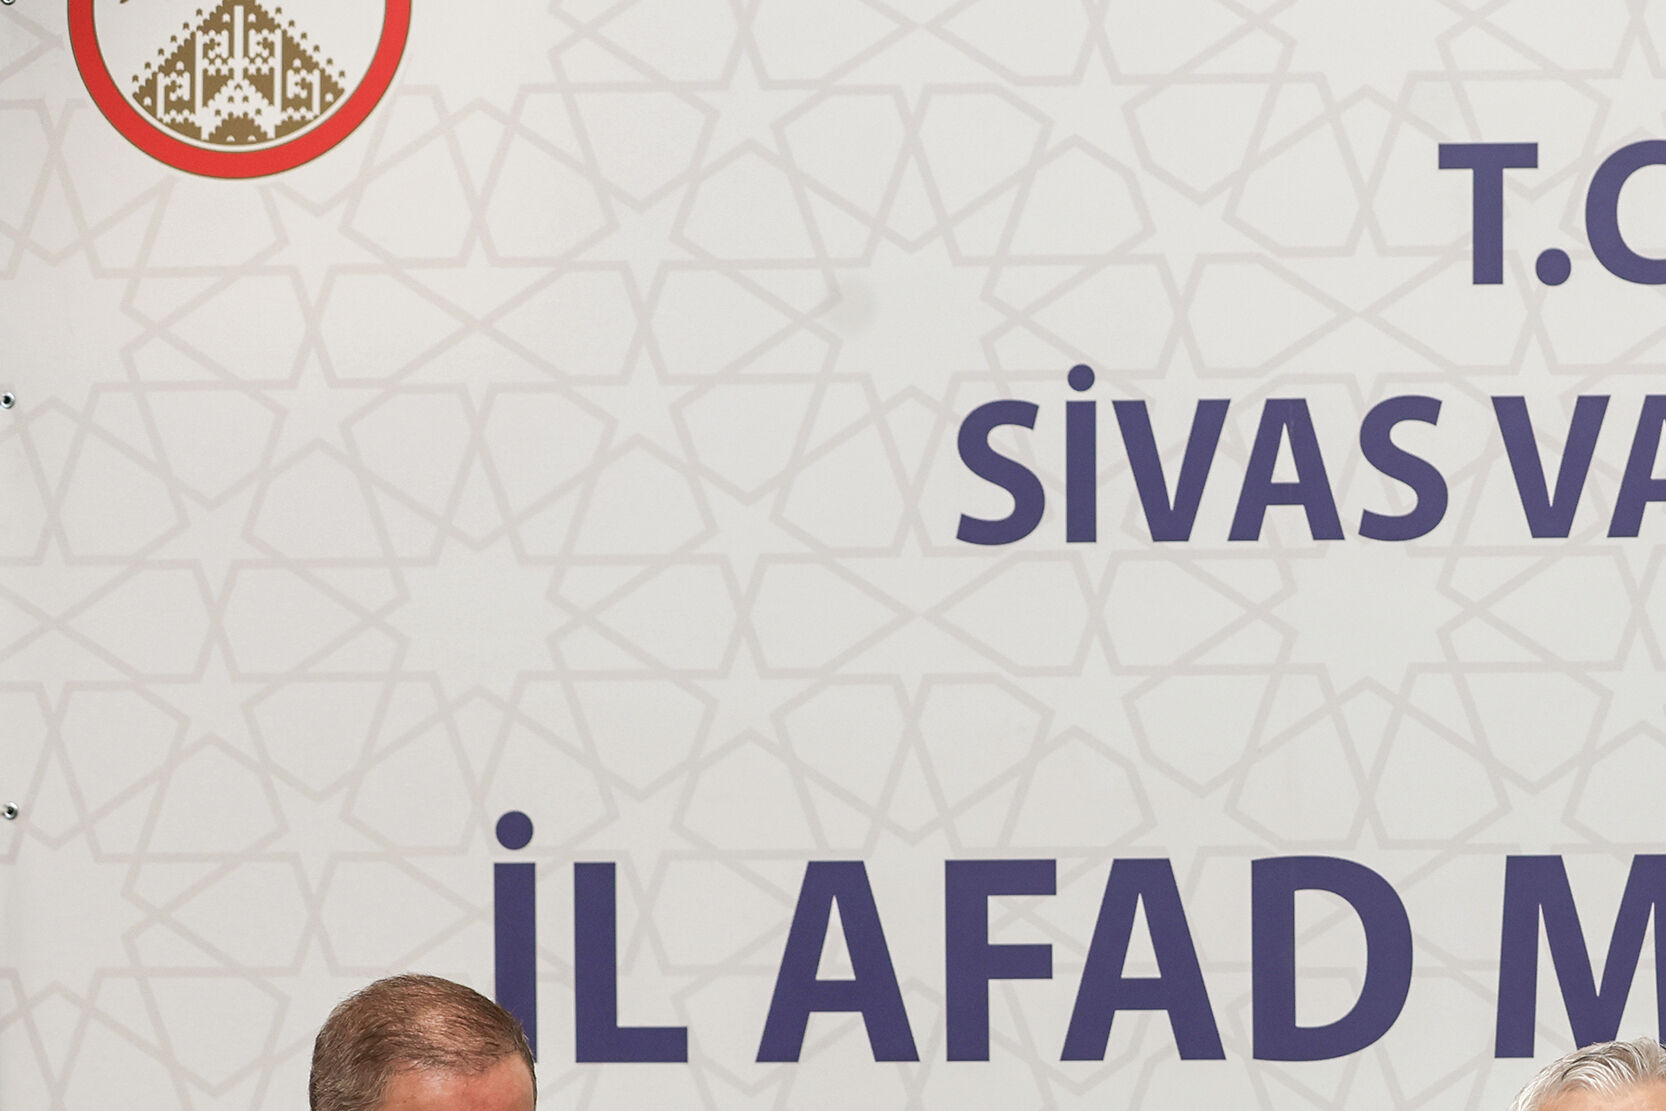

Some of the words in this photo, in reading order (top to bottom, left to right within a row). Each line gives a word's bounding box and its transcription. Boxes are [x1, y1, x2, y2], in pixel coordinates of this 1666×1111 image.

[957, 364, 1447, 546] SİVAS
[493, 810, 688, 1062] İL
[756, 856, 1413, 1062] AFAD
